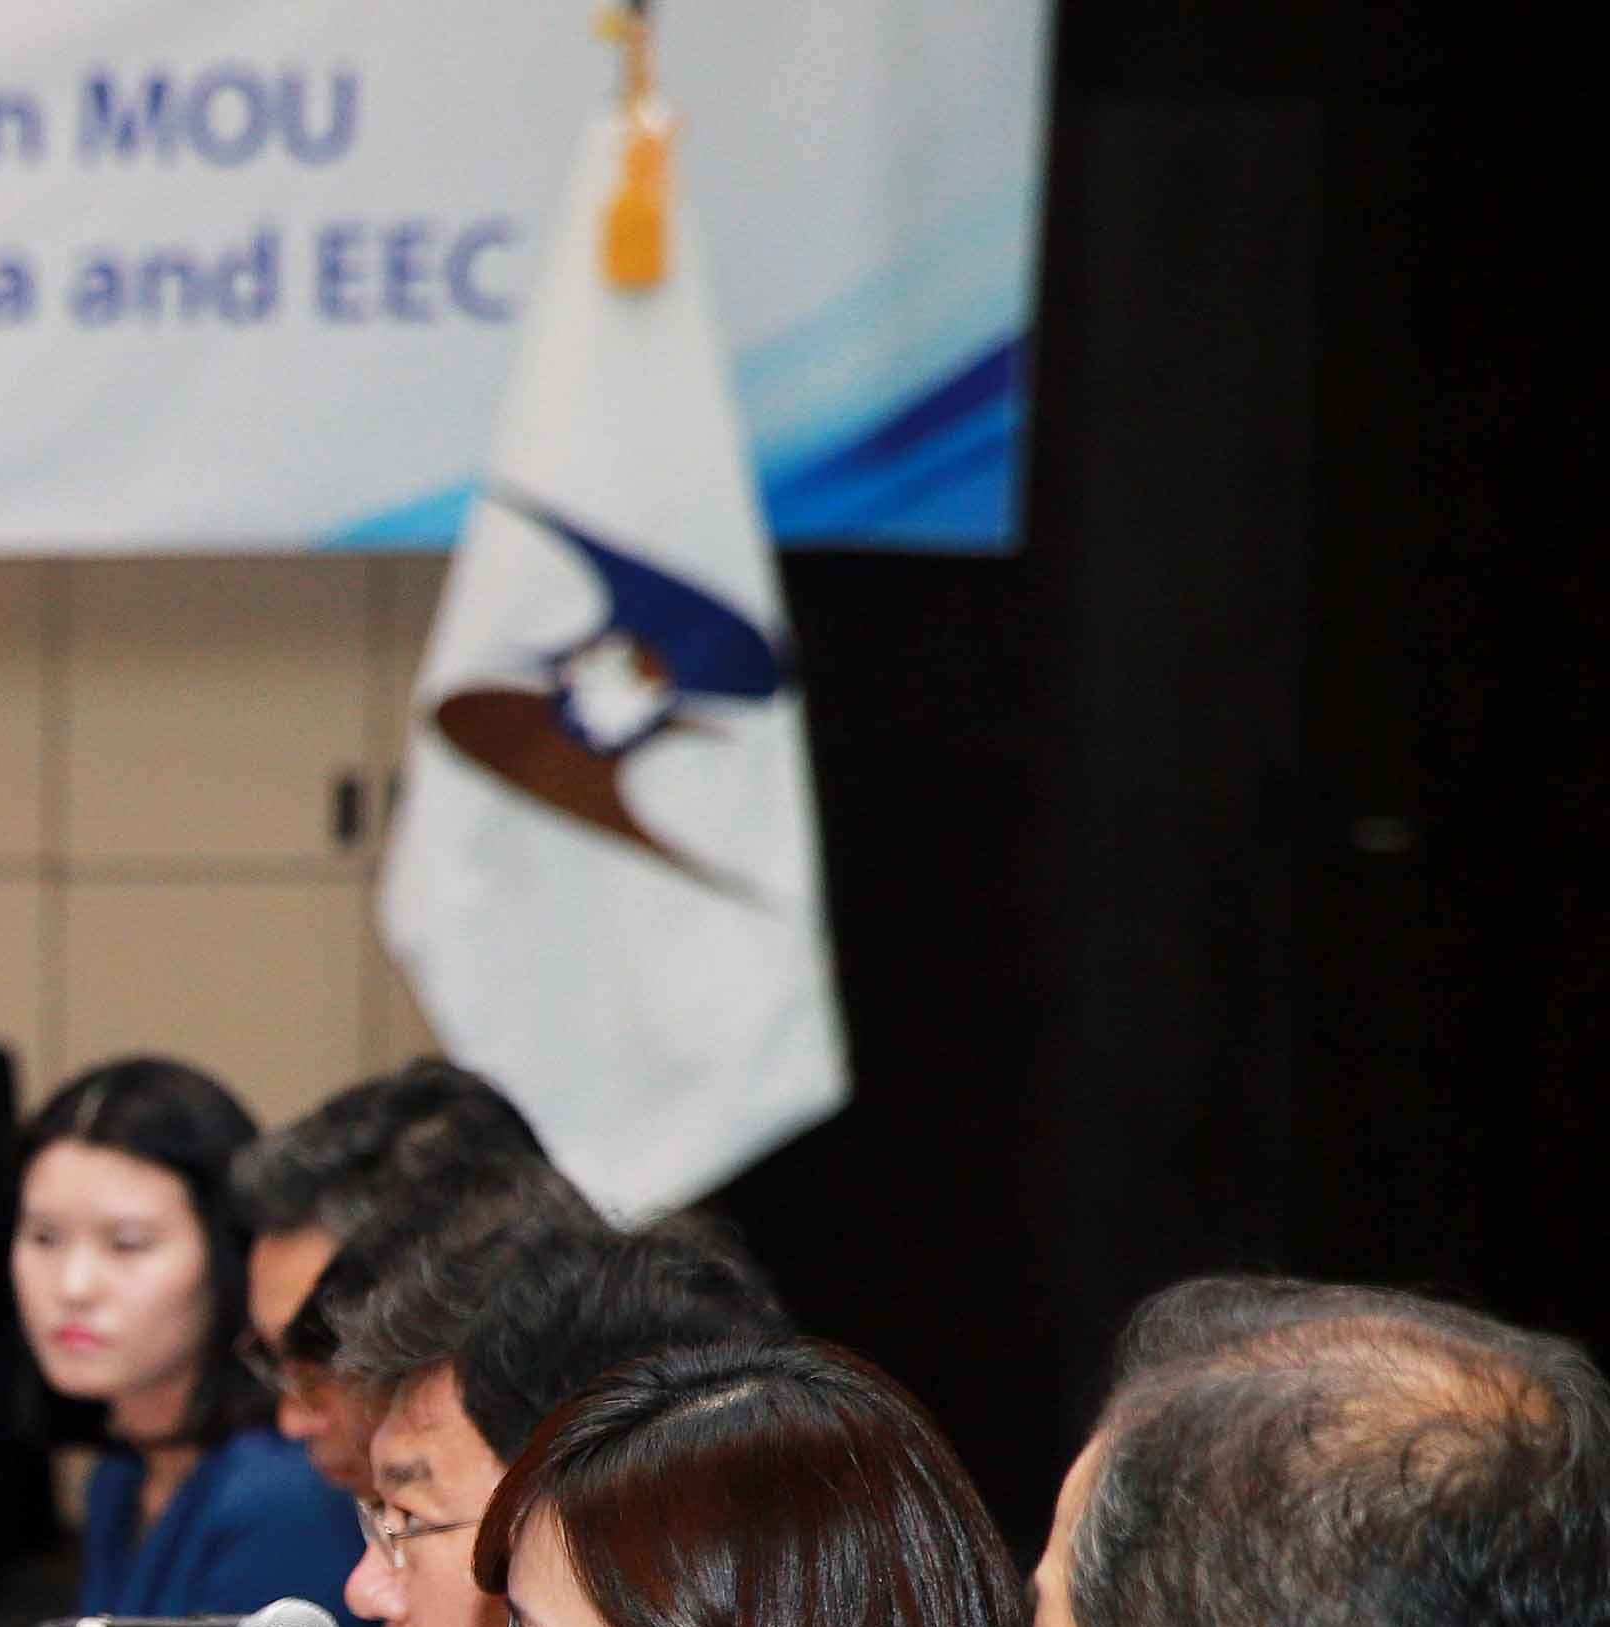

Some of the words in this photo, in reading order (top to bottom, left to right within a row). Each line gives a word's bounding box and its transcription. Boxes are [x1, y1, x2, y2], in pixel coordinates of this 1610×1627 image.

[77, 70, 359, 166] MOU
[69, 230, 281, 324] and
[315, 221, 519, 325] EEC
